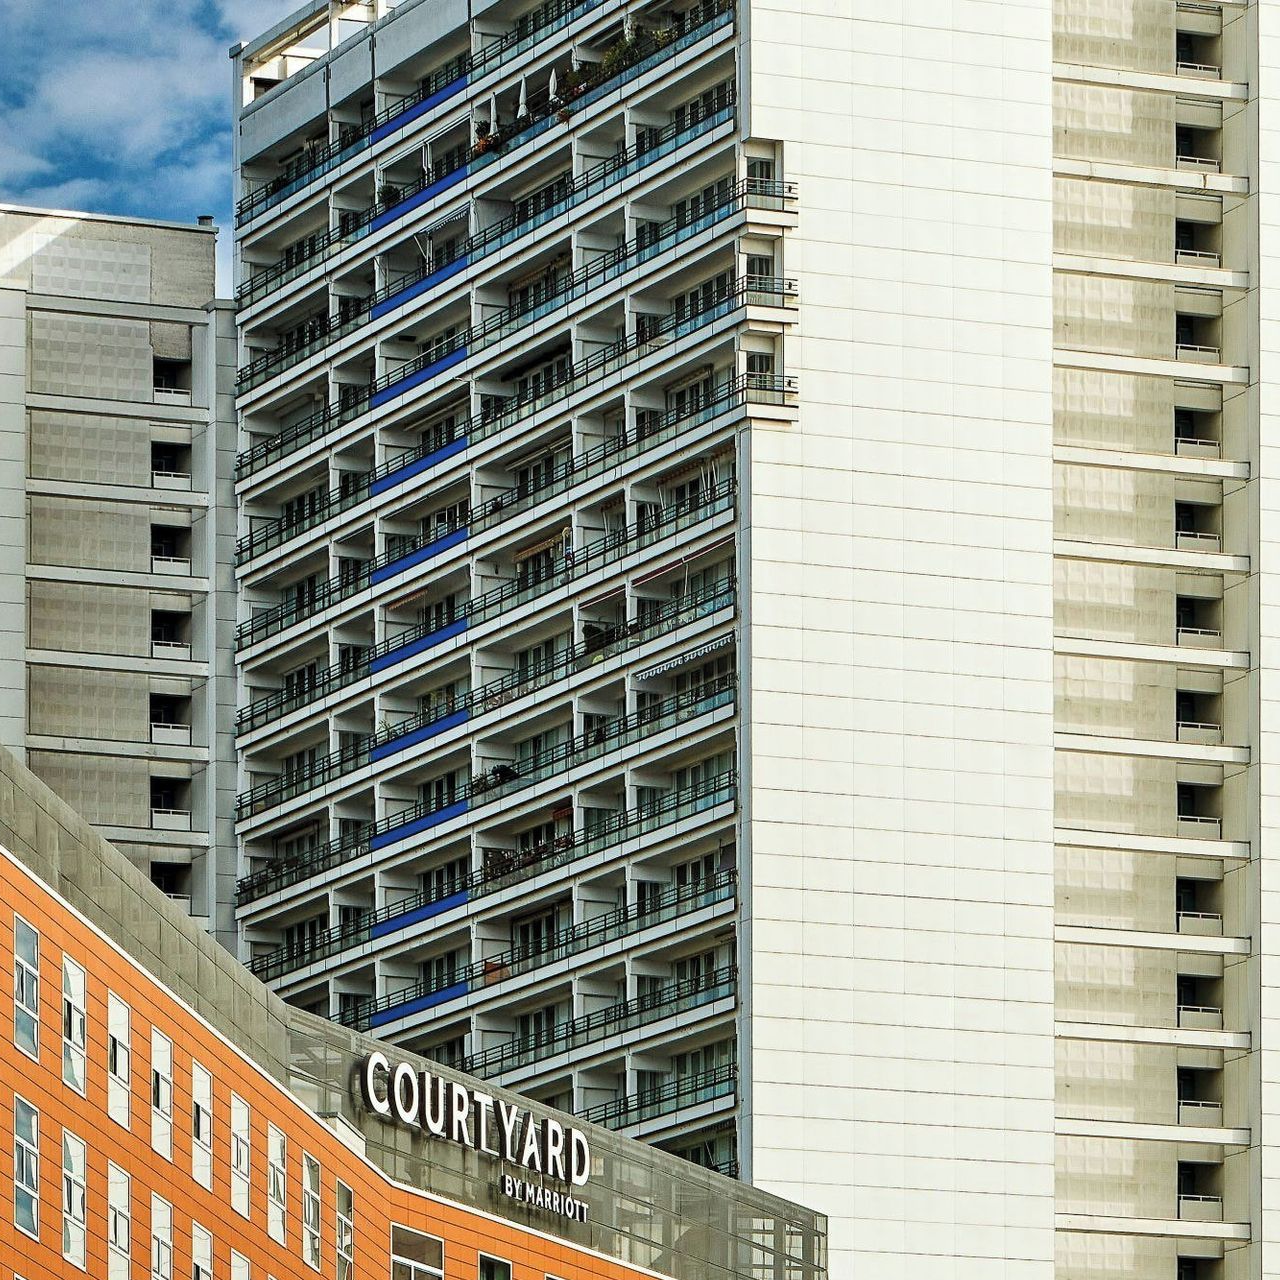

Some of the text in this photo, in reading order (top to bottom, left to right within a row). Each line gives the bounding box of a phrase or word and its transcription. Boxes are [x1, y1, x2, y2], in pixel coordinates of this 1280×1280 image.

[365, 1051, 590, 1187] COURTYARD
[505, 1175, 589, 1223] BY MARRIOTT
